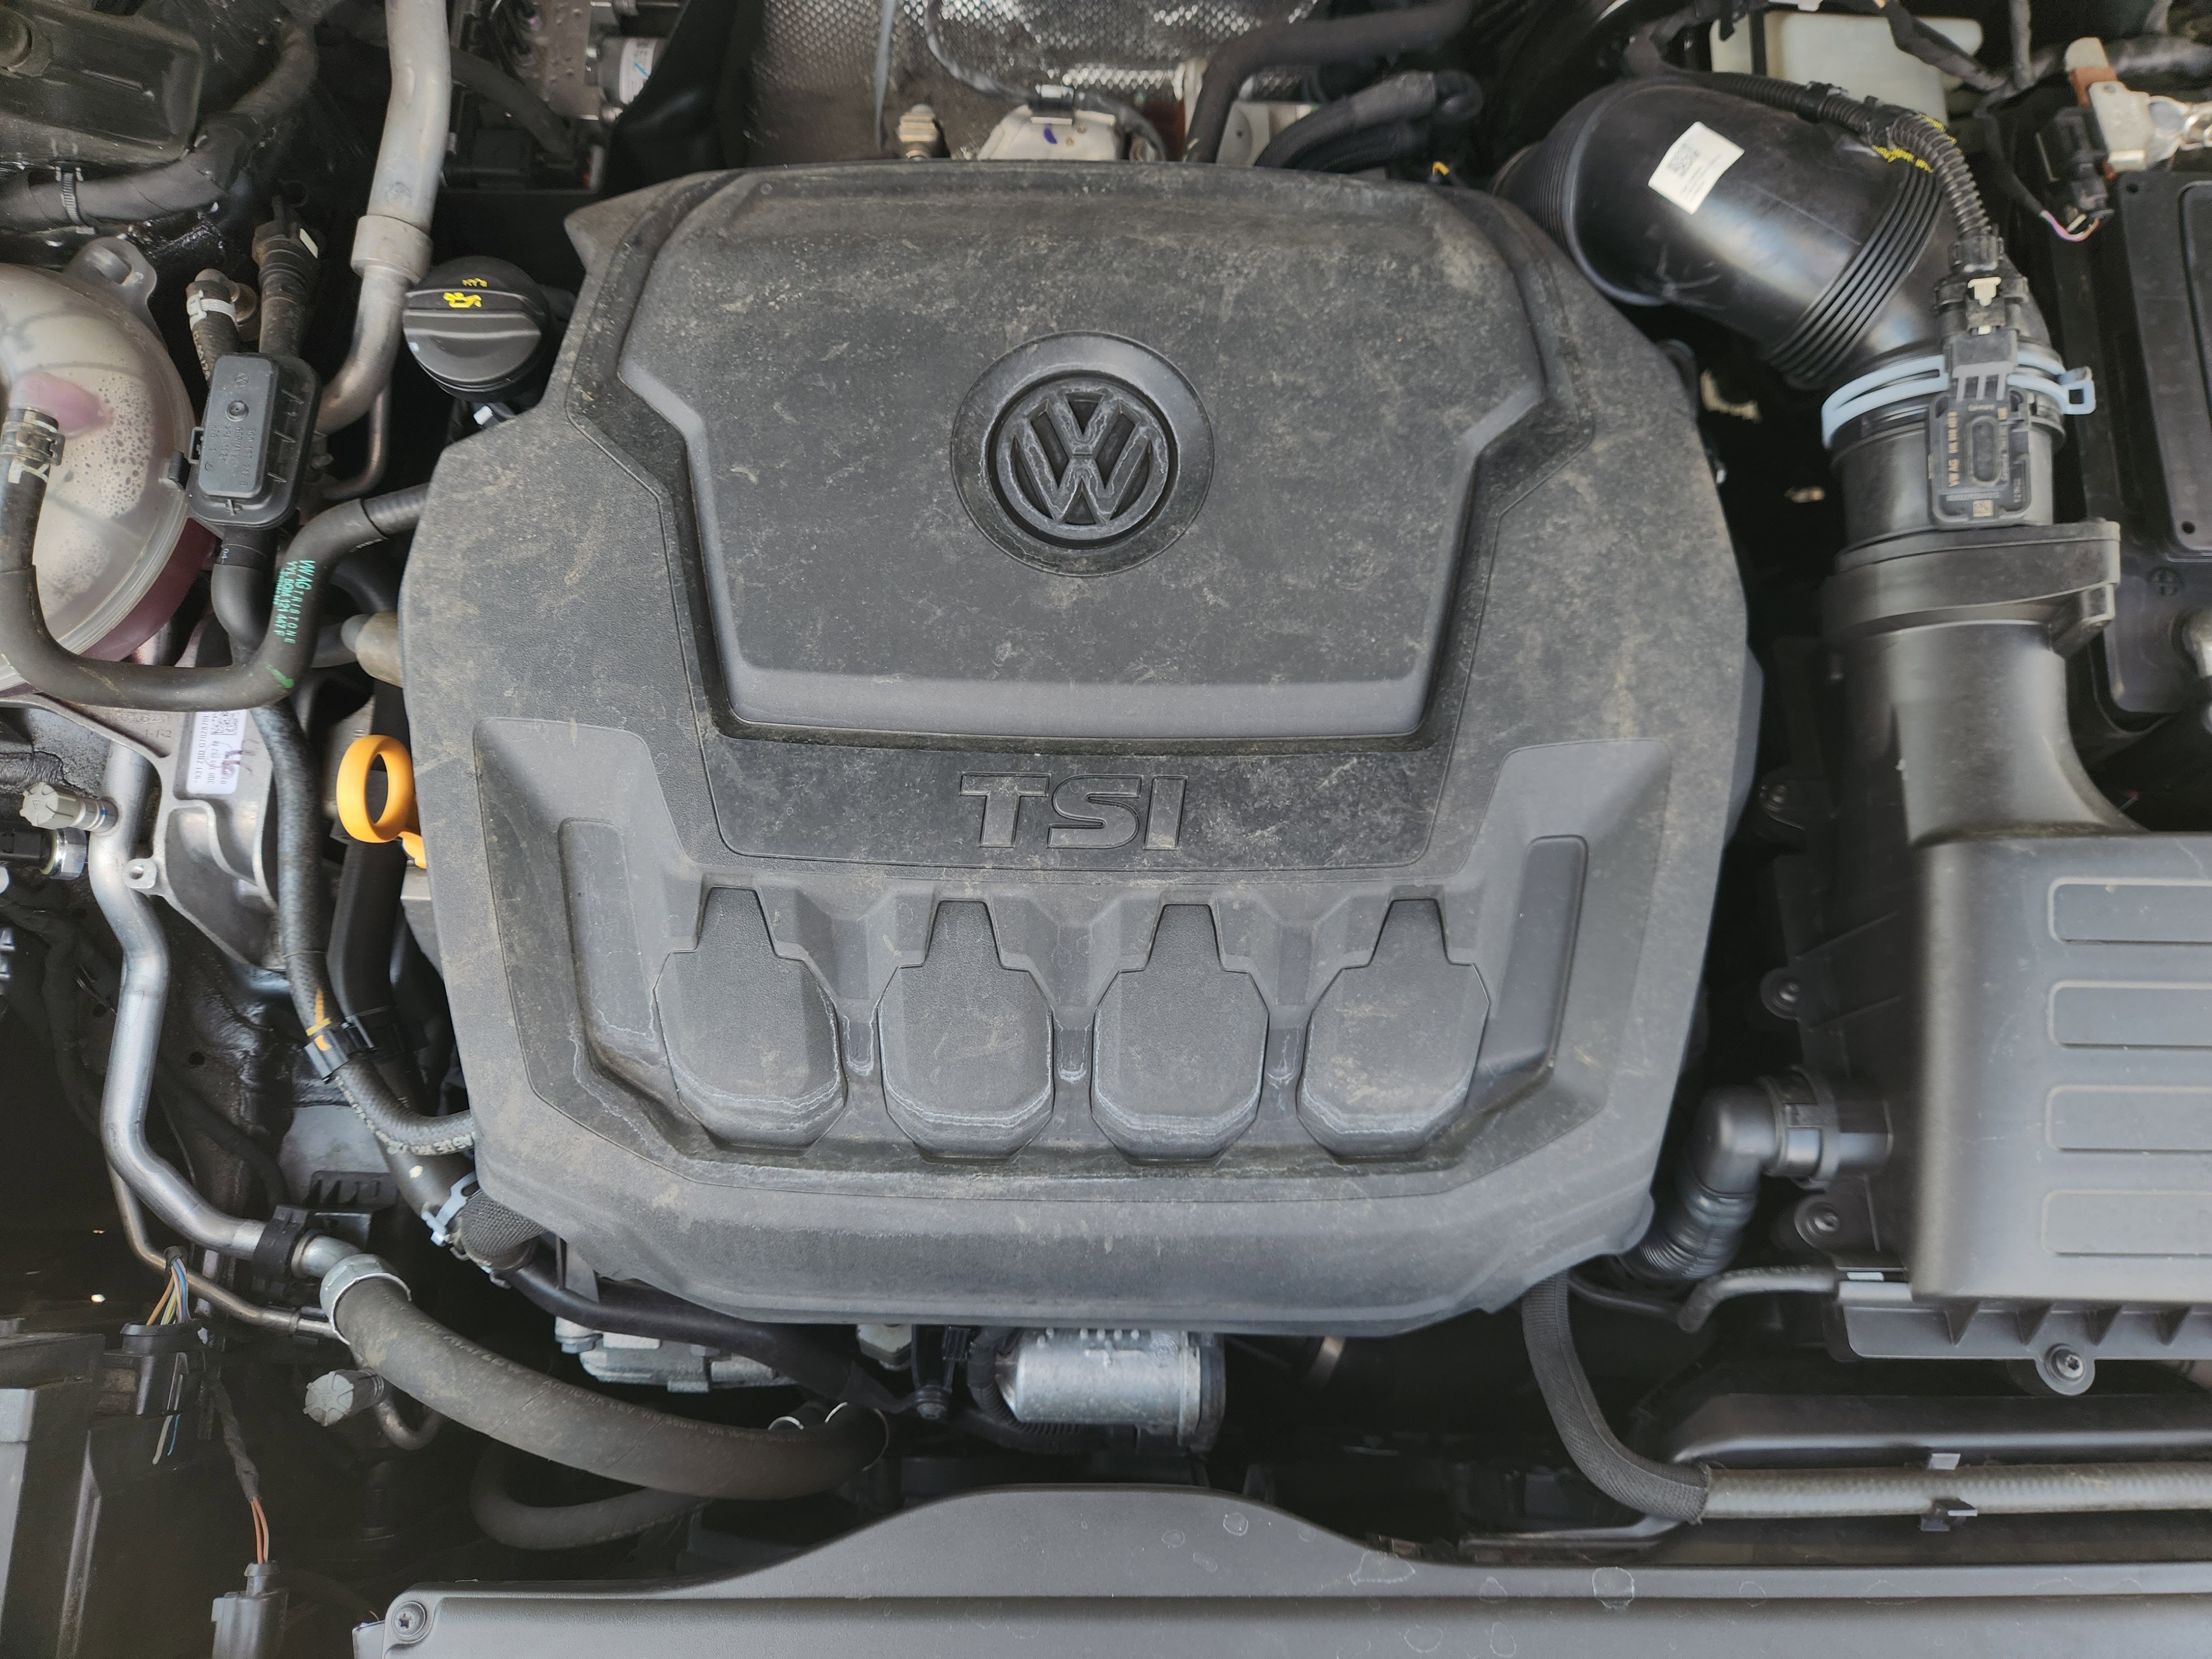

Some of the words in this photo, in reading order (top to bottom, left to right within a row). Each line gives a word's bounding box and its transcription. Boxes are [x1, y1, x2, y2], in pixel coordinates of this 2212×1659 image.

[232, 427, 243, 459] GERMANY
[1004, 384, 1162, 532] VW
[959, 771, 1188, 851] TSI
